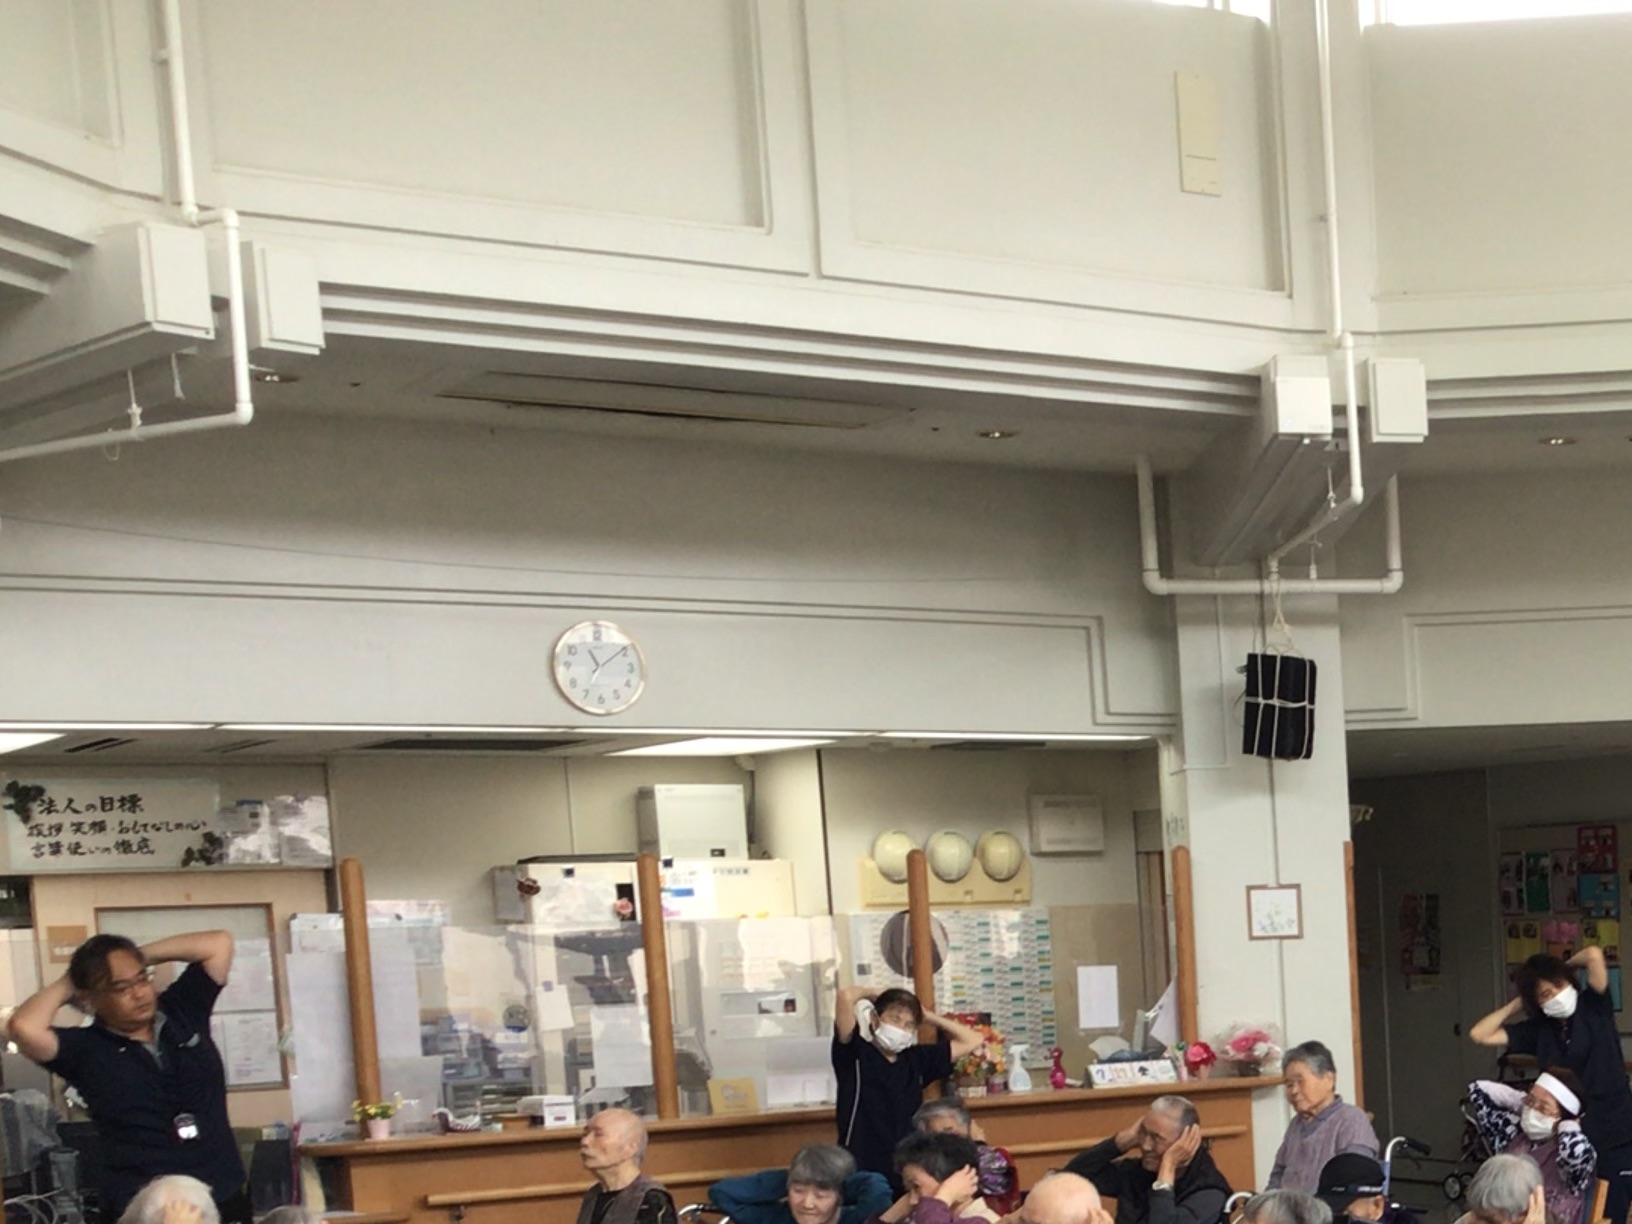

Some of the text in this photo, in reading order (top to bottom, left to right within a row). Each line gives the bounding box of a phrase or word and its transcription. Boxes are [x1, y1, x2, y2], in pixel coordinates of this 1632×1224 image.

[567, 645, 578, 656] 10
[627, 662, 635, 674] 3
[623, 679, 632, 688] 4
[582, 689, 589, 699] 7
[597, 693, 605, 704] 6
[613, 689, 621, 700] 5
[37, 793, 145, 815] 法人の目標
